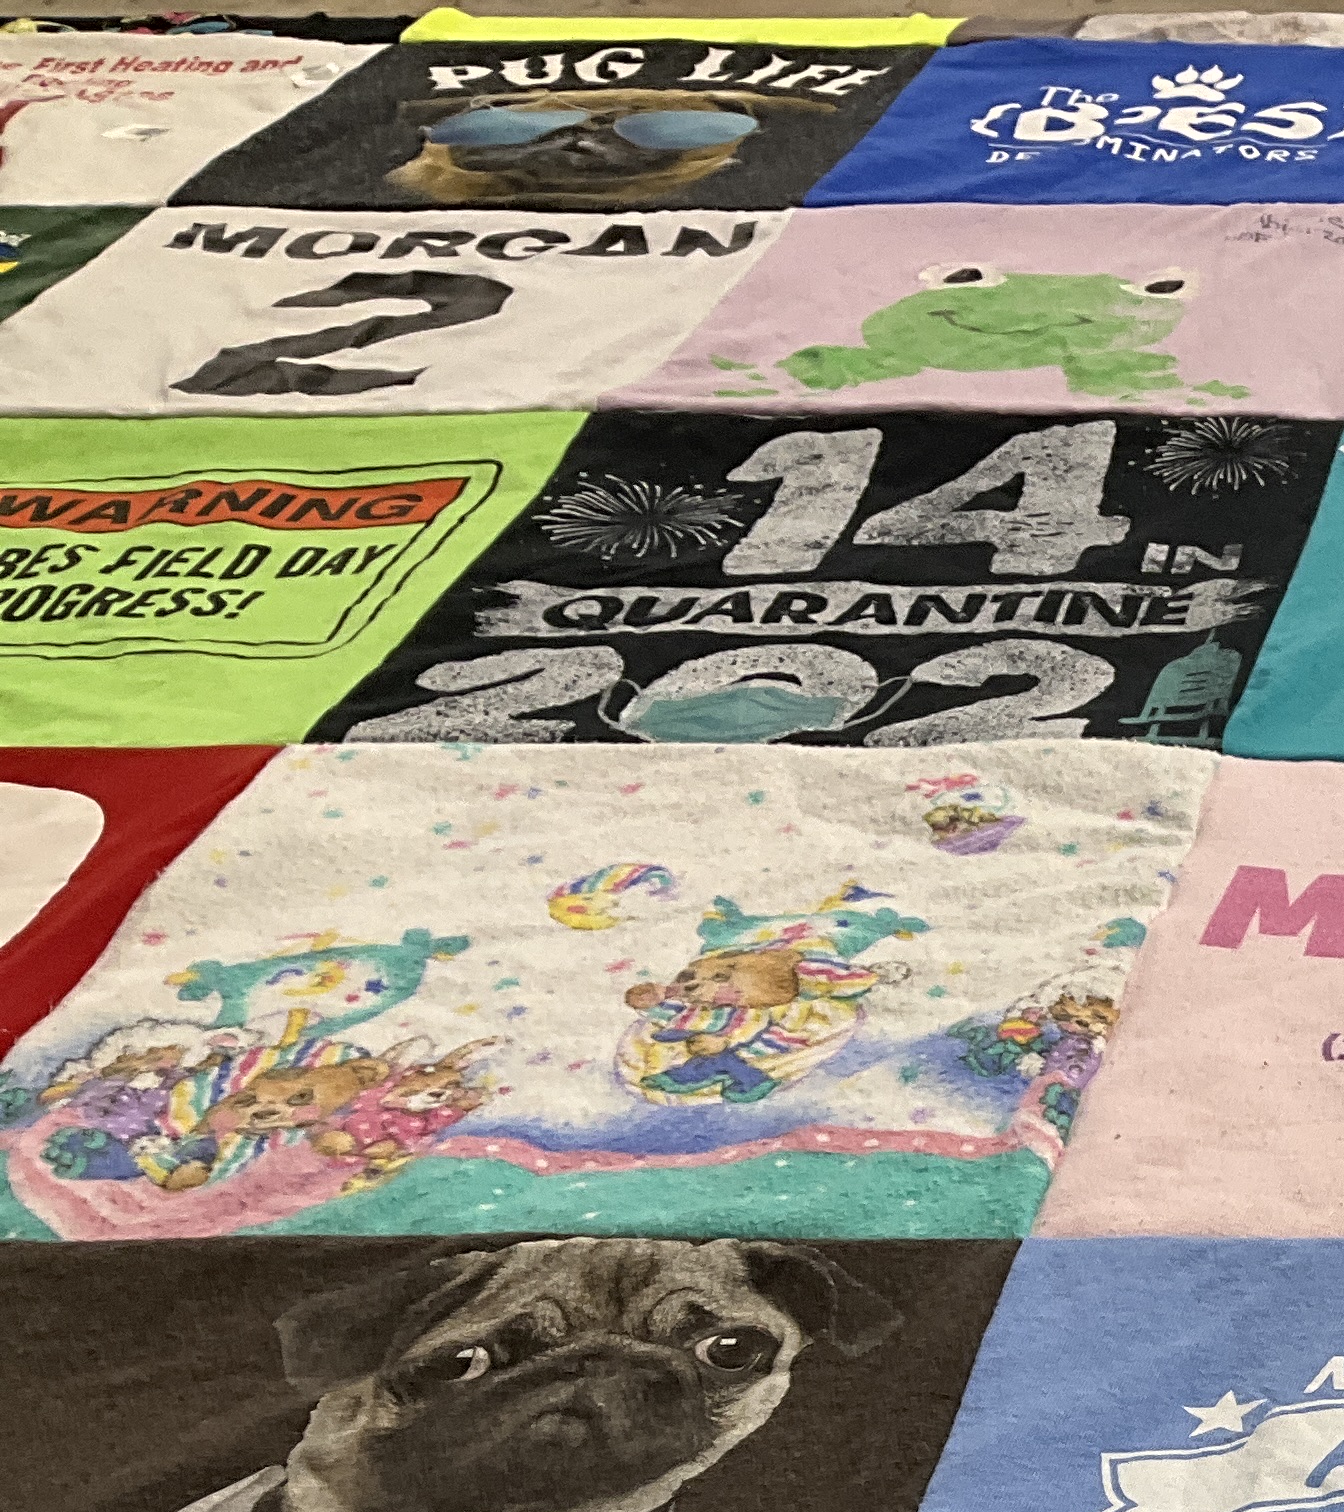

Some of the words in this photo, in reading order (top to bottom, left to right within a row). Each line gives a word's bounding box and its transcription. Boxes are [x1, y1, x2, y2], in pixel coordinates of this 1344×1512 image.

[33, 57, 106, 75] First
[109, 55, 236, 77] Heating
[428, 46, 645, 91] PUG
[680, 46, 892, 96] LIFE
[164, 221, 758, 260] MORGAN
[169, 270, 514, 397] 2
[0, 488, 424, 524] WARNING
[723, 420, 1132, 577] 14
[1141, 542, 1244, 575] IN
[98, 544, 273, 582] FIELD
[274, 543, 399, 581] DAY
[542, 589, 1194, 630] QUARANTINE
